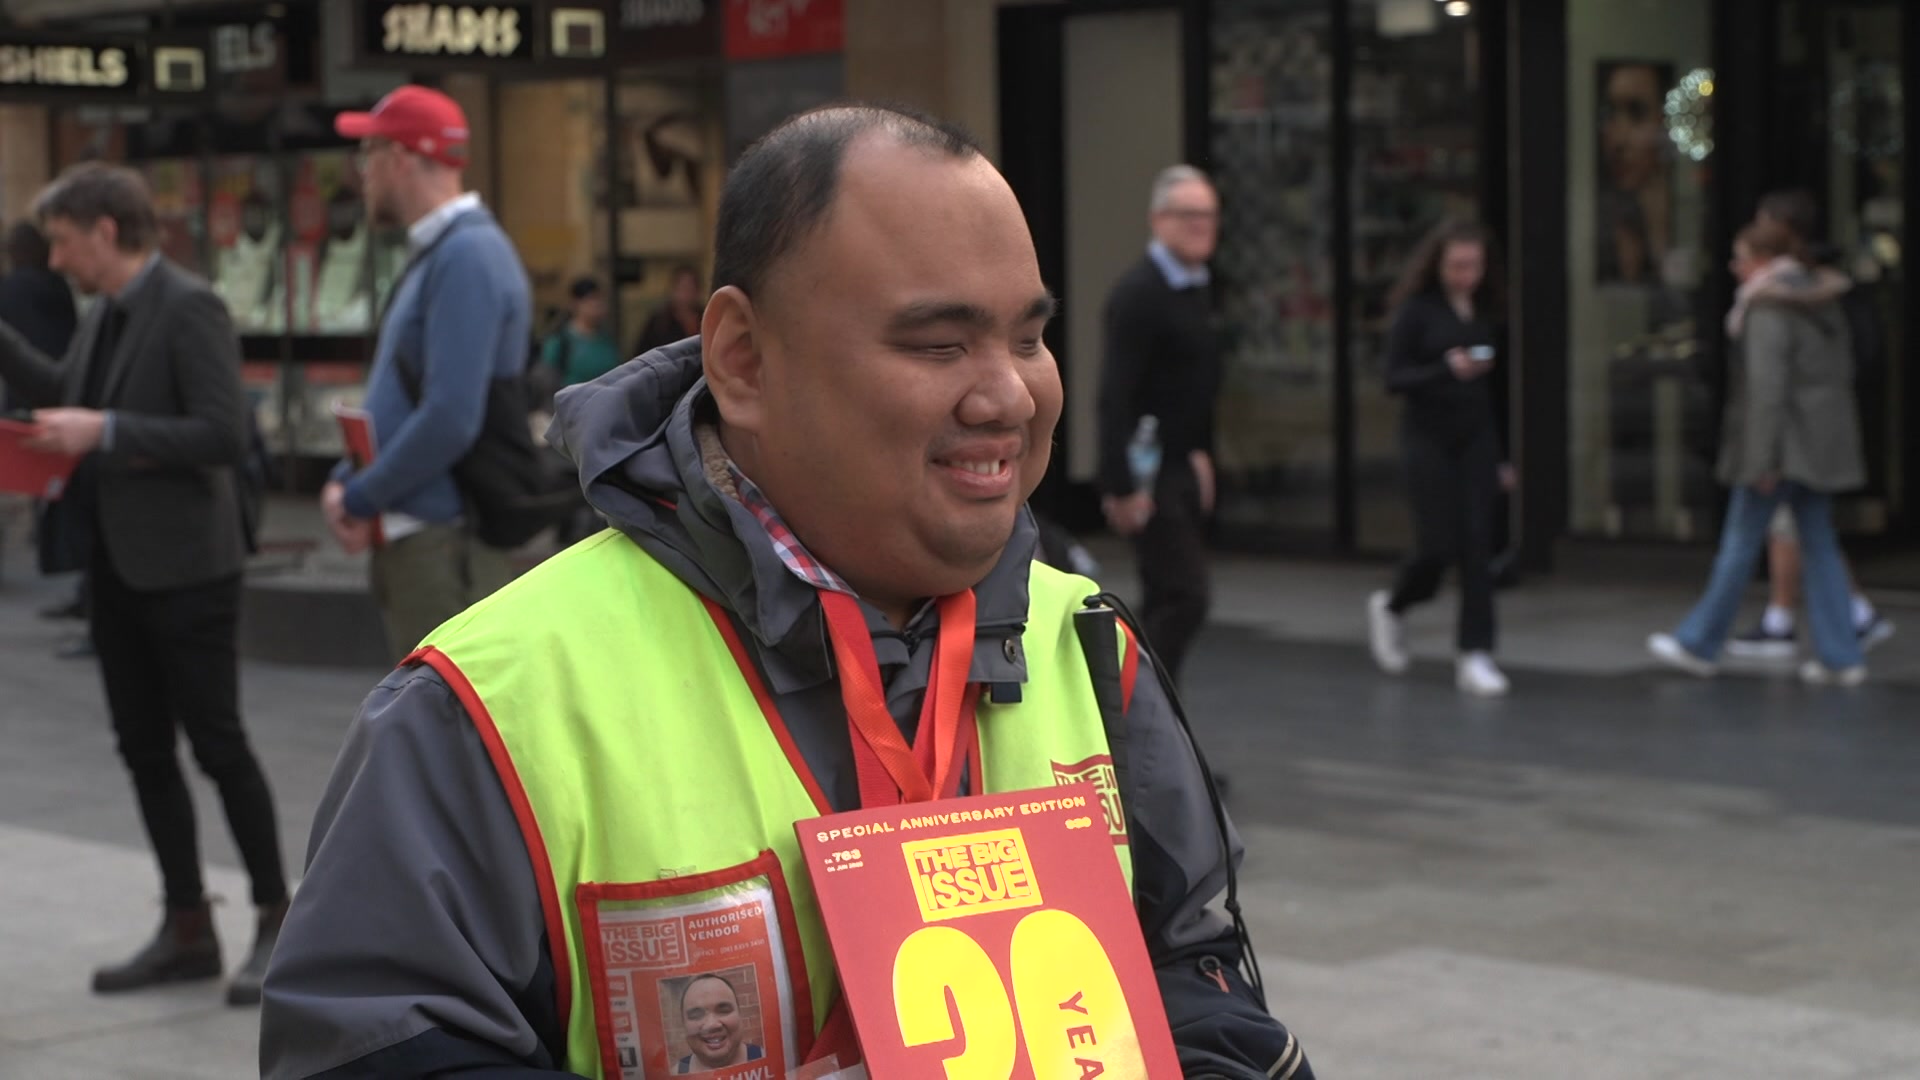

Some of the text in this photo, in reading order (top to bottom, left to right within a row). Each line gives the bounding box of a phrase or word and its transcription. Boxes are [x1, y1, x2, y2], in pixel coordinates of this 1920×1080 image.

[382, 4, 520, 55] SHADES
[0, 46, 127, 86] SHIELS
[816, 796, 1086, 842] SPECIAL ANNIVERSARY EDITION
[914, 839, 1020, 873] THE BIG
[920, 860, 1031, 911] ISSUE
[602, 922, 675, 942] THE BIG
[688, 905, 763, 930] AUTHORISED
[689, 924, 740, 942] VENDOR
[605, 937, 681, 964] ISSUE
